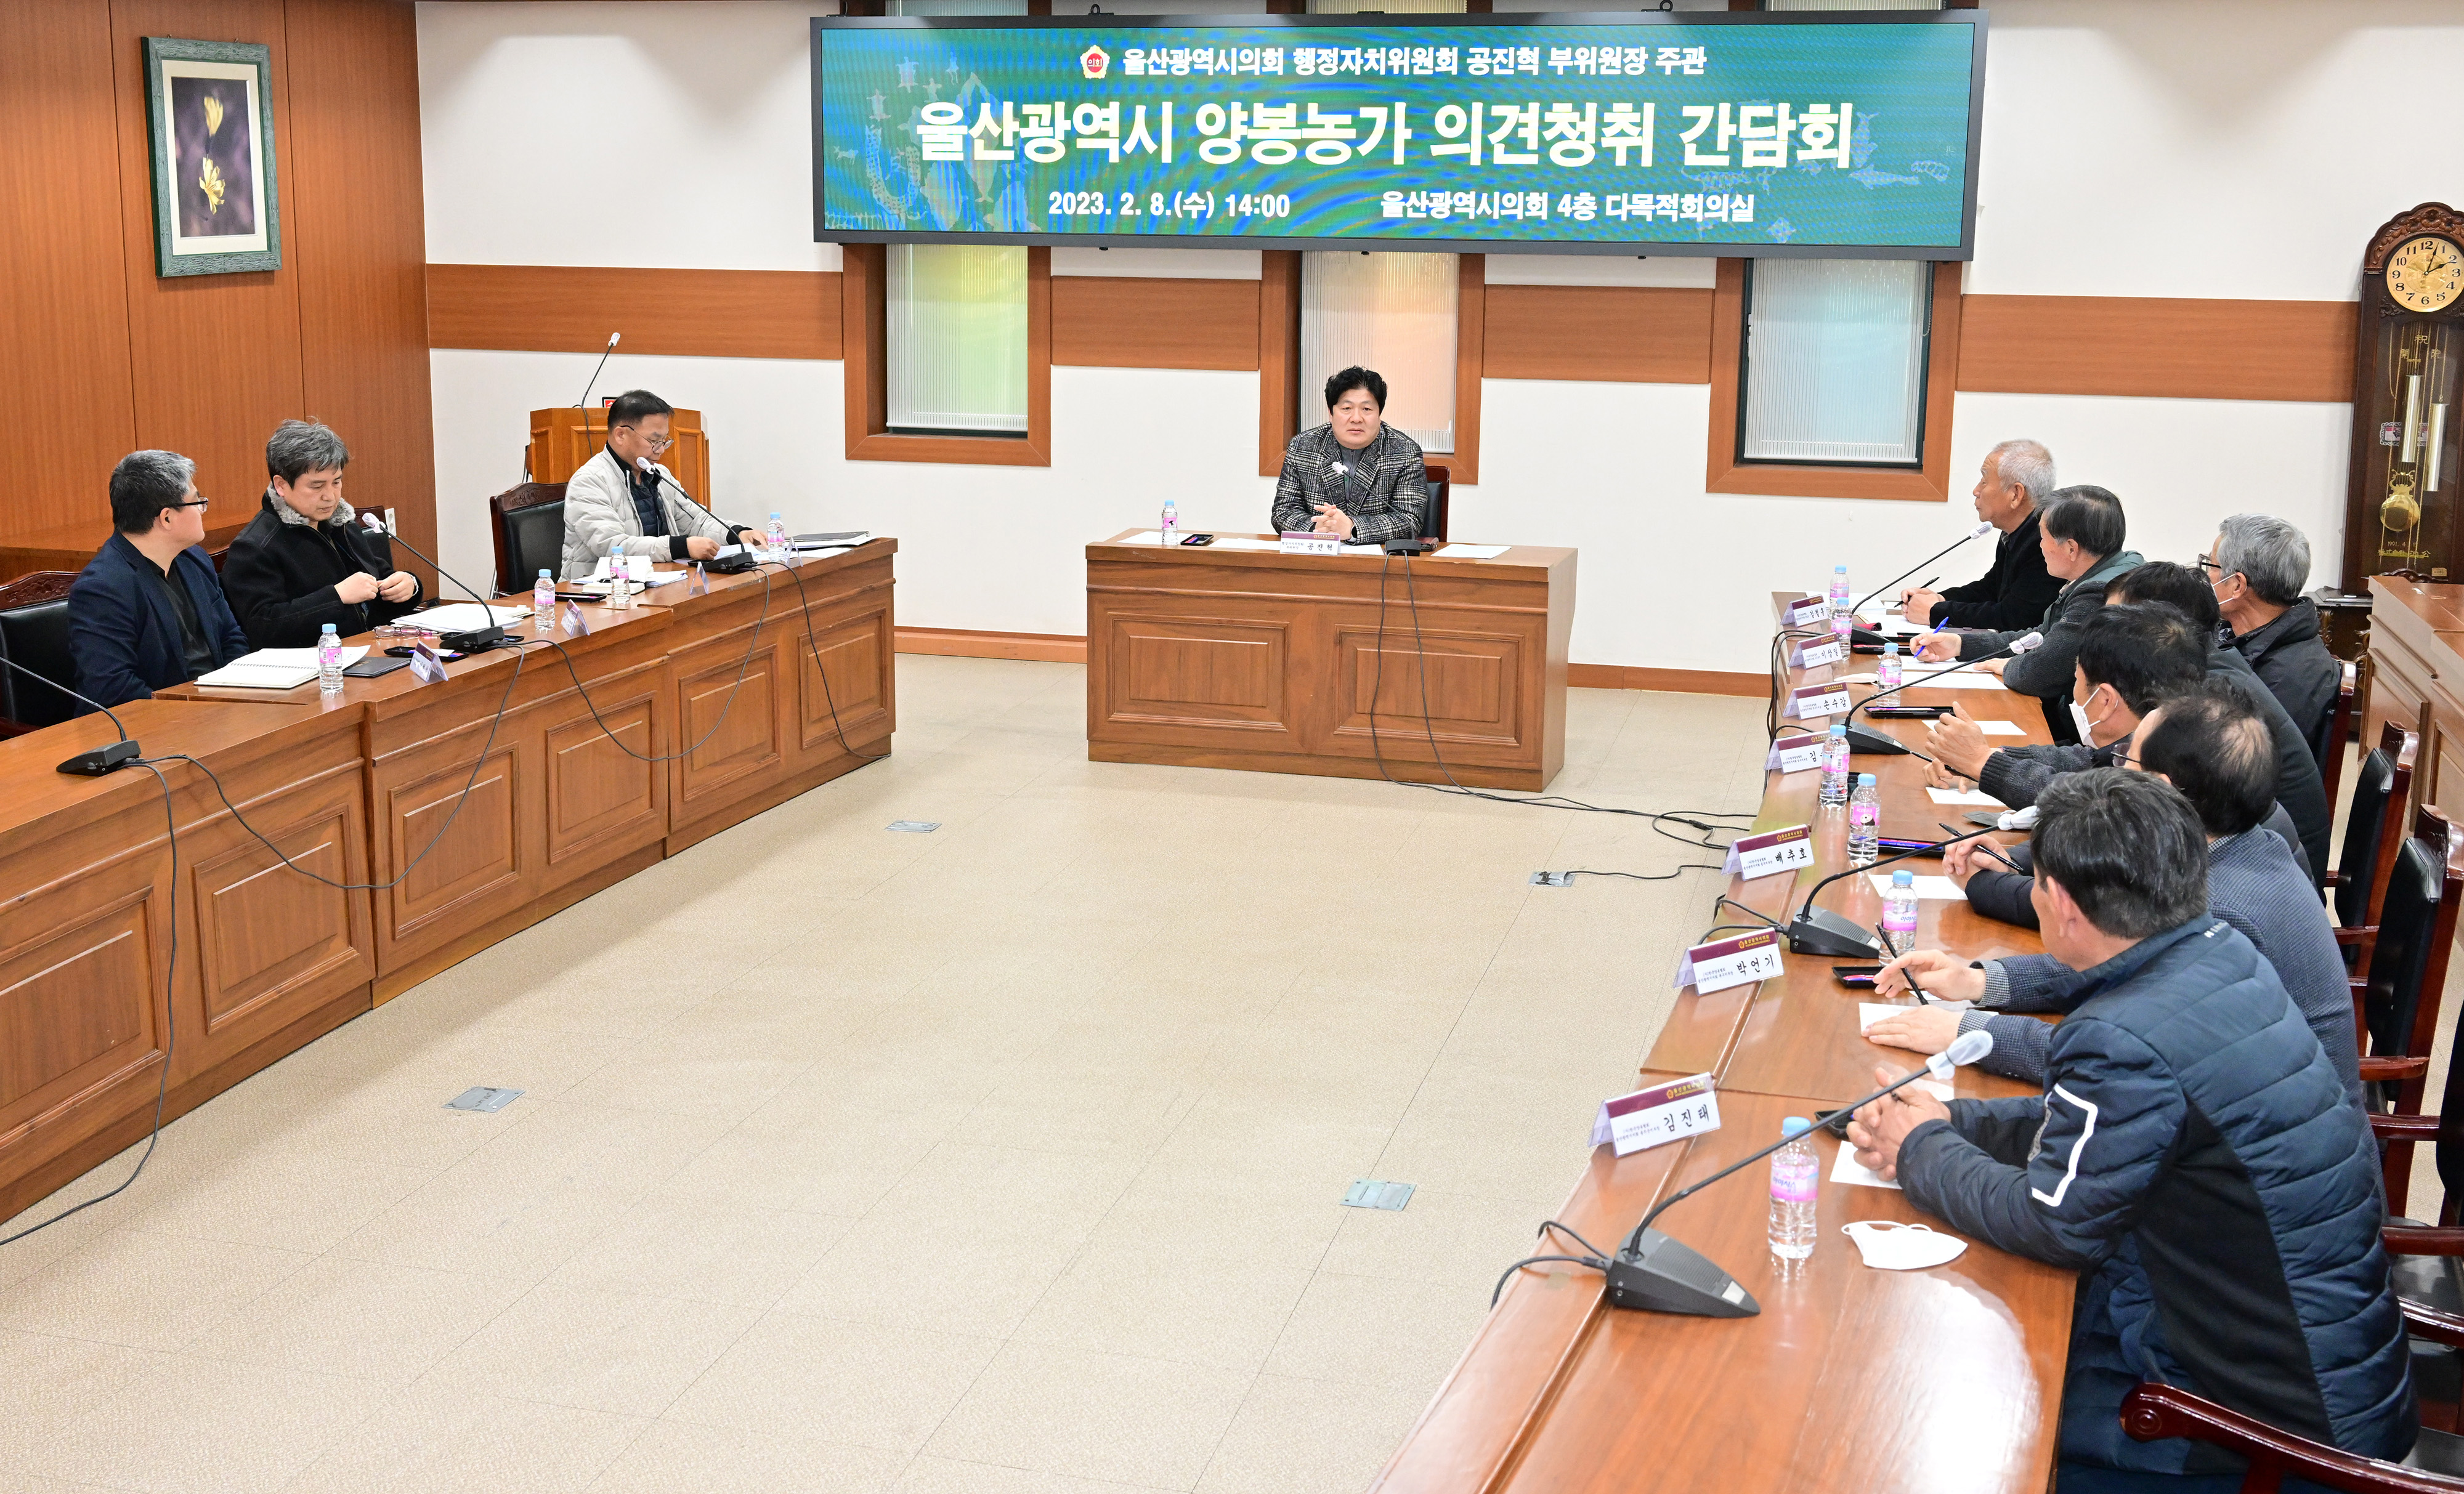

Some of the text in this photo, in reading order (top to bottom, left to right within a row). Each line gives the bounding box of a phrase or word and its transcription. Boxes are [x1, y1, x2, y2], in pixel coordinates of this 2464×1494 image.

[1088, 58, 1102, 67] 의회
[1123, 46, 1708, 76] 울산광역시의회 행정자치위원회 공진혁 부위원장 주관
[917, 101, 1853, 169] 울산광역시 양봉농가 의견청취 간담회
[1048, 191, 1290, 219] 2023. 2. 8.(수) 14:00
[1380, 190, 1754, 222] 울산광역시의회 4층 다목적회의실
[2420, 241, 2433, 250] 12
[2442, 245, 2446, 254] 1
[2406, 246, 2417, 255] 11
[2396, 257, 2407, 265] 10
[2449, 255, 2457, 264] 2
[2392, 270, 2401, 278] 9
[2452, 269, 2460, 277] 3
[2395, 283, 2405, 291] 8
[2446, 281, 2455, 289] 4
[2406, 293, 2415, 301] 7
[2421, 296, 2430, 304] 6
[2436, 292, 2446, 301] 5
[1307, 543, 1332, 551] 공진혁
[1823, 697, 1847, 711] 손수갑
[1775, 847, 1807, 865] 배추호
[1736, 953, 1775, 977] 박언기
[1663, 1104, 1710, 1133] 김진태
